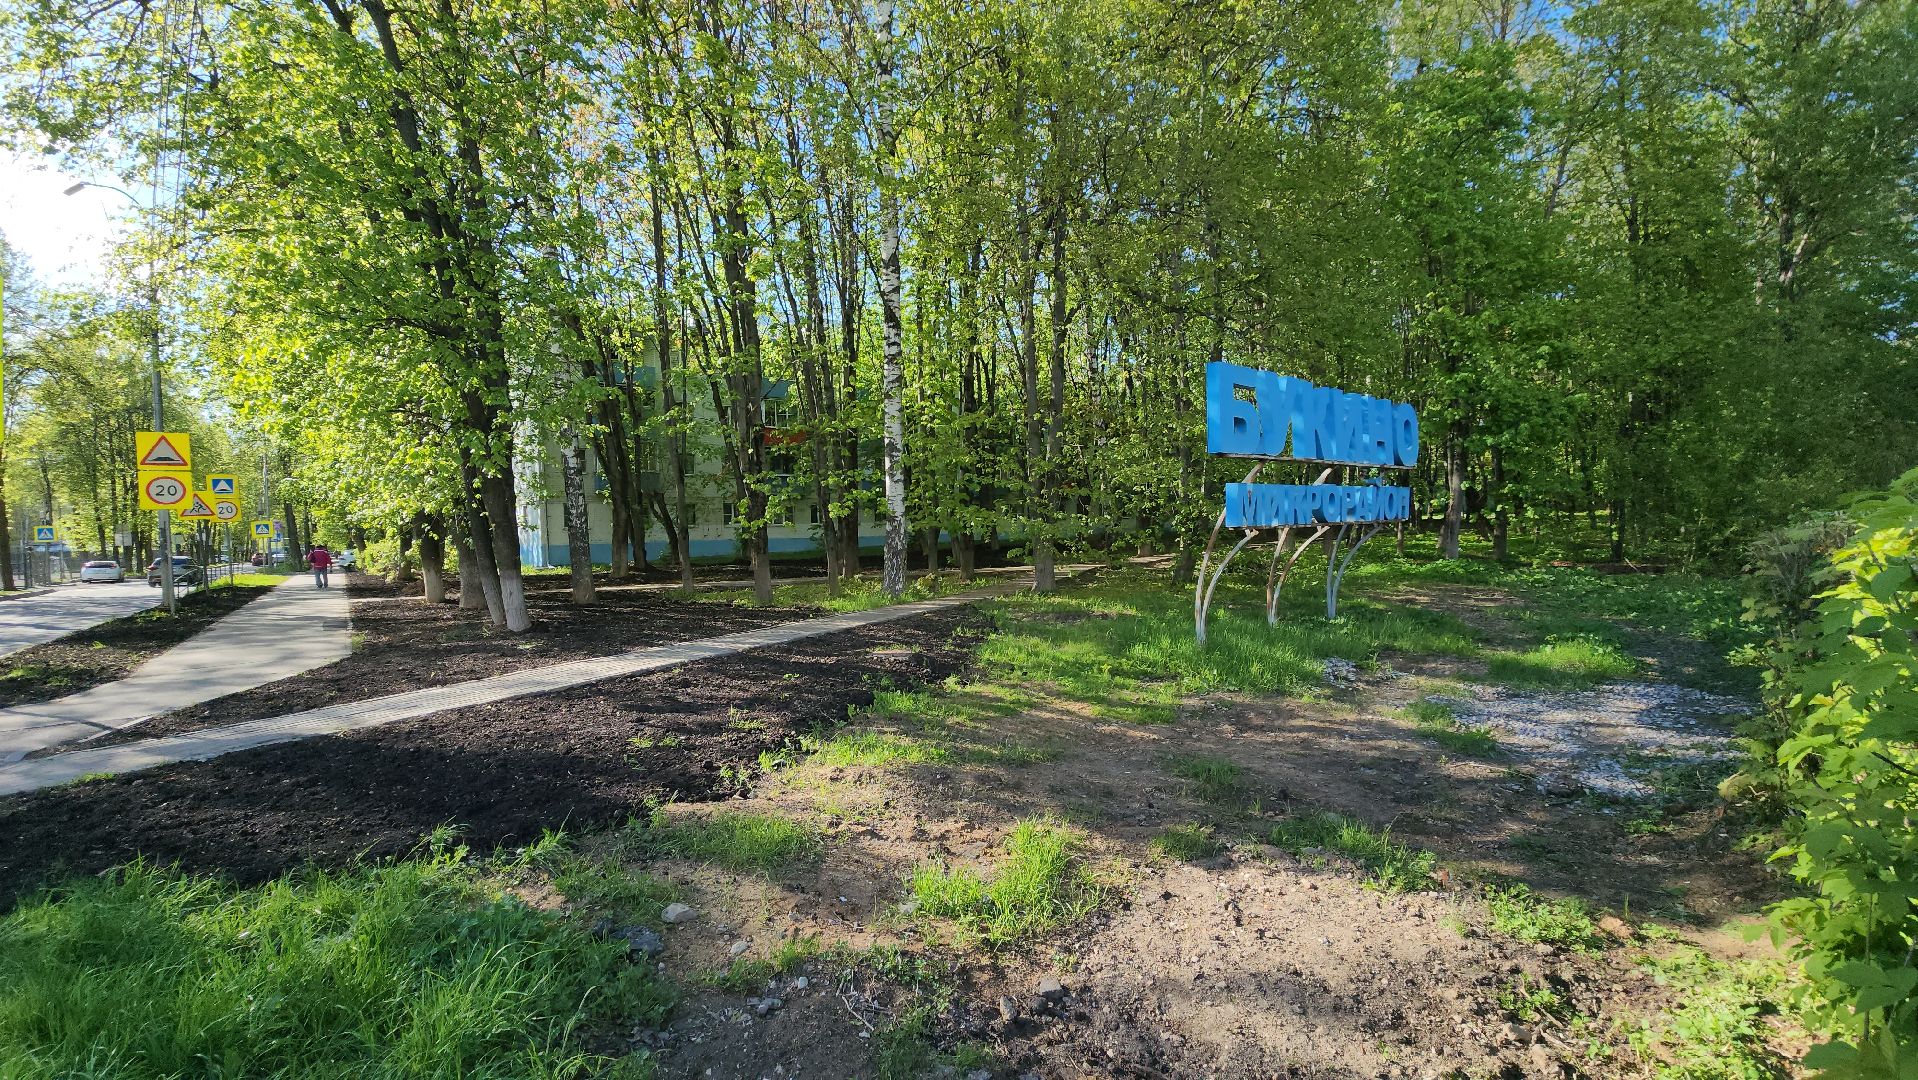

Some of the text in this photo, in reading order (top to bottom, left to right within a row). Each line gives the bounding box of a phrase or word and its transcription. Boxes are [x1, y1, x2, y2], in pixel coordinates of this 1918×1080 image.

[1207, 362, 1419, 466] БУКИНО
[155, 485, 177, 496] 20
[1225, 477, 1411, 528] МИКРОРАЙОН
[218, 506, 233, 514] 20
